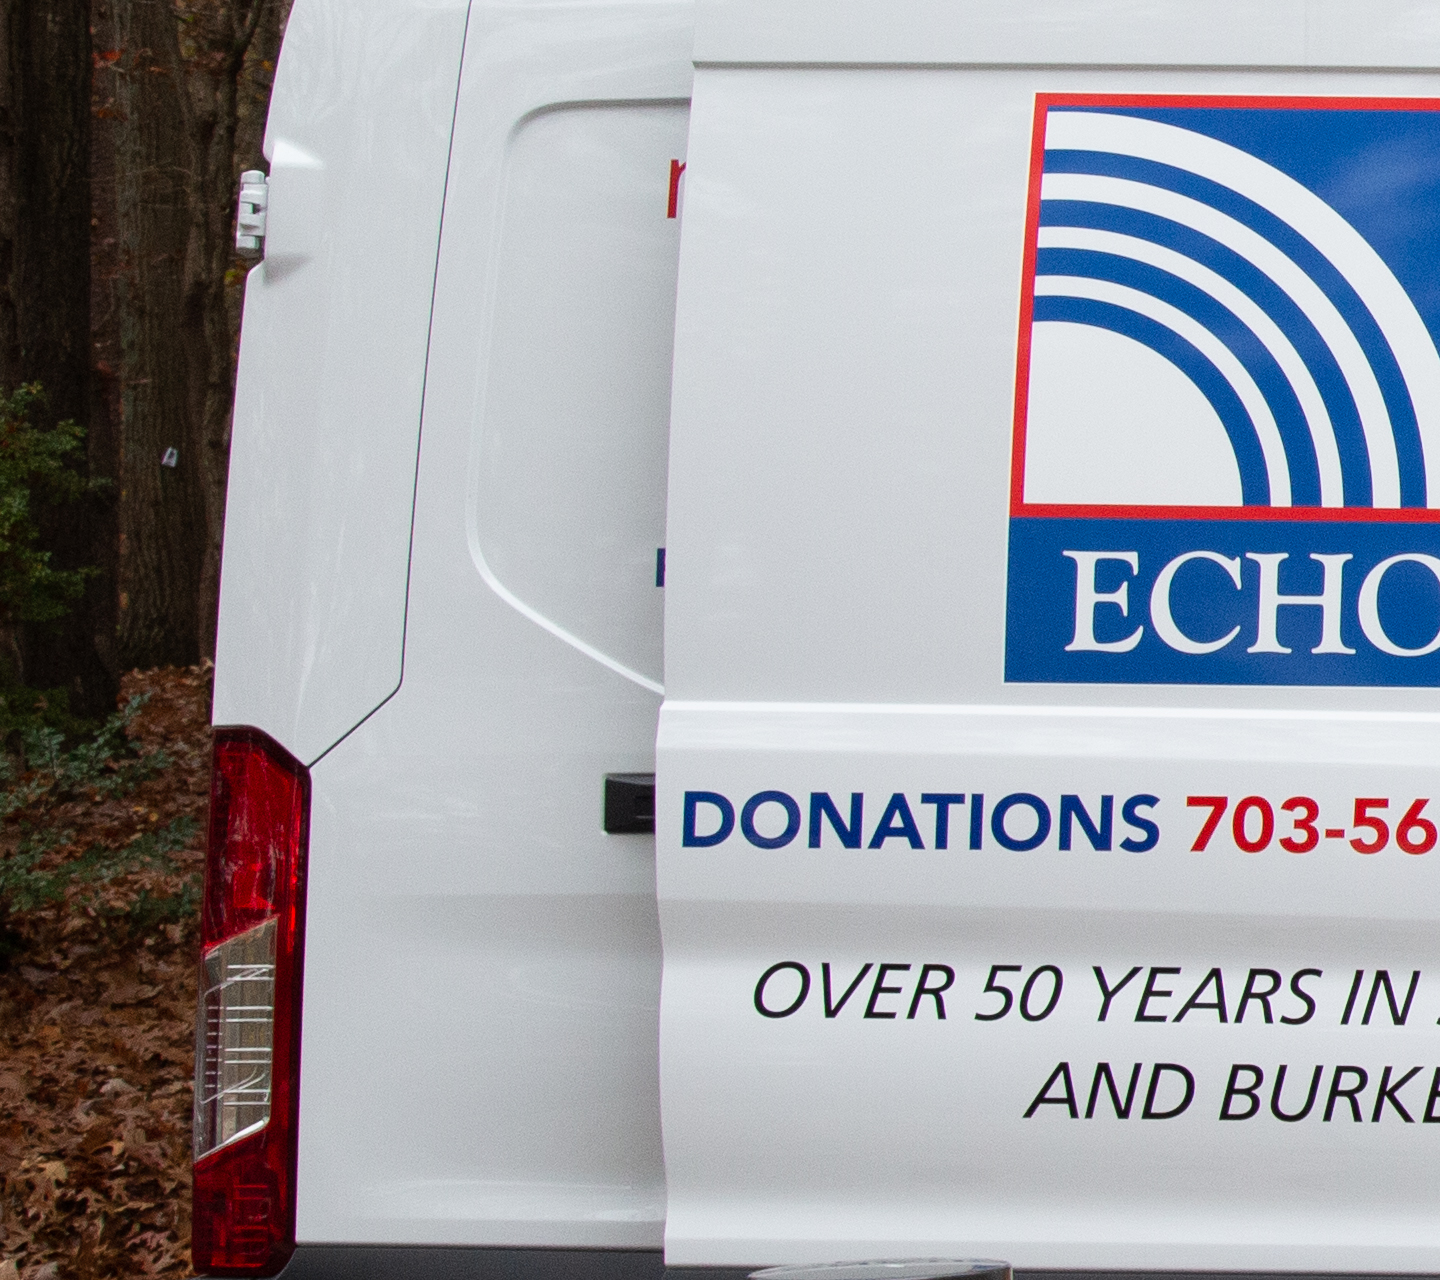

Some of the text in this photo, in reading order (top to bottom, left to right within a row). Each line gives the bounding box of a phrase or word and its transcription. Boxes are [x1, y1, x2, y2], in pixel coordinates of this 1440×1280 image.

[681, 789, 1160, 854] DONATIONS
[752, 959, 957, 1021] OVER
[973, 963, 1065, 1023] 50
[1090, 964, 1323, 1027] YEARS
[1340, 968, 1419, 1027] IN
[1022, 1060, 1197, 1121] AND
